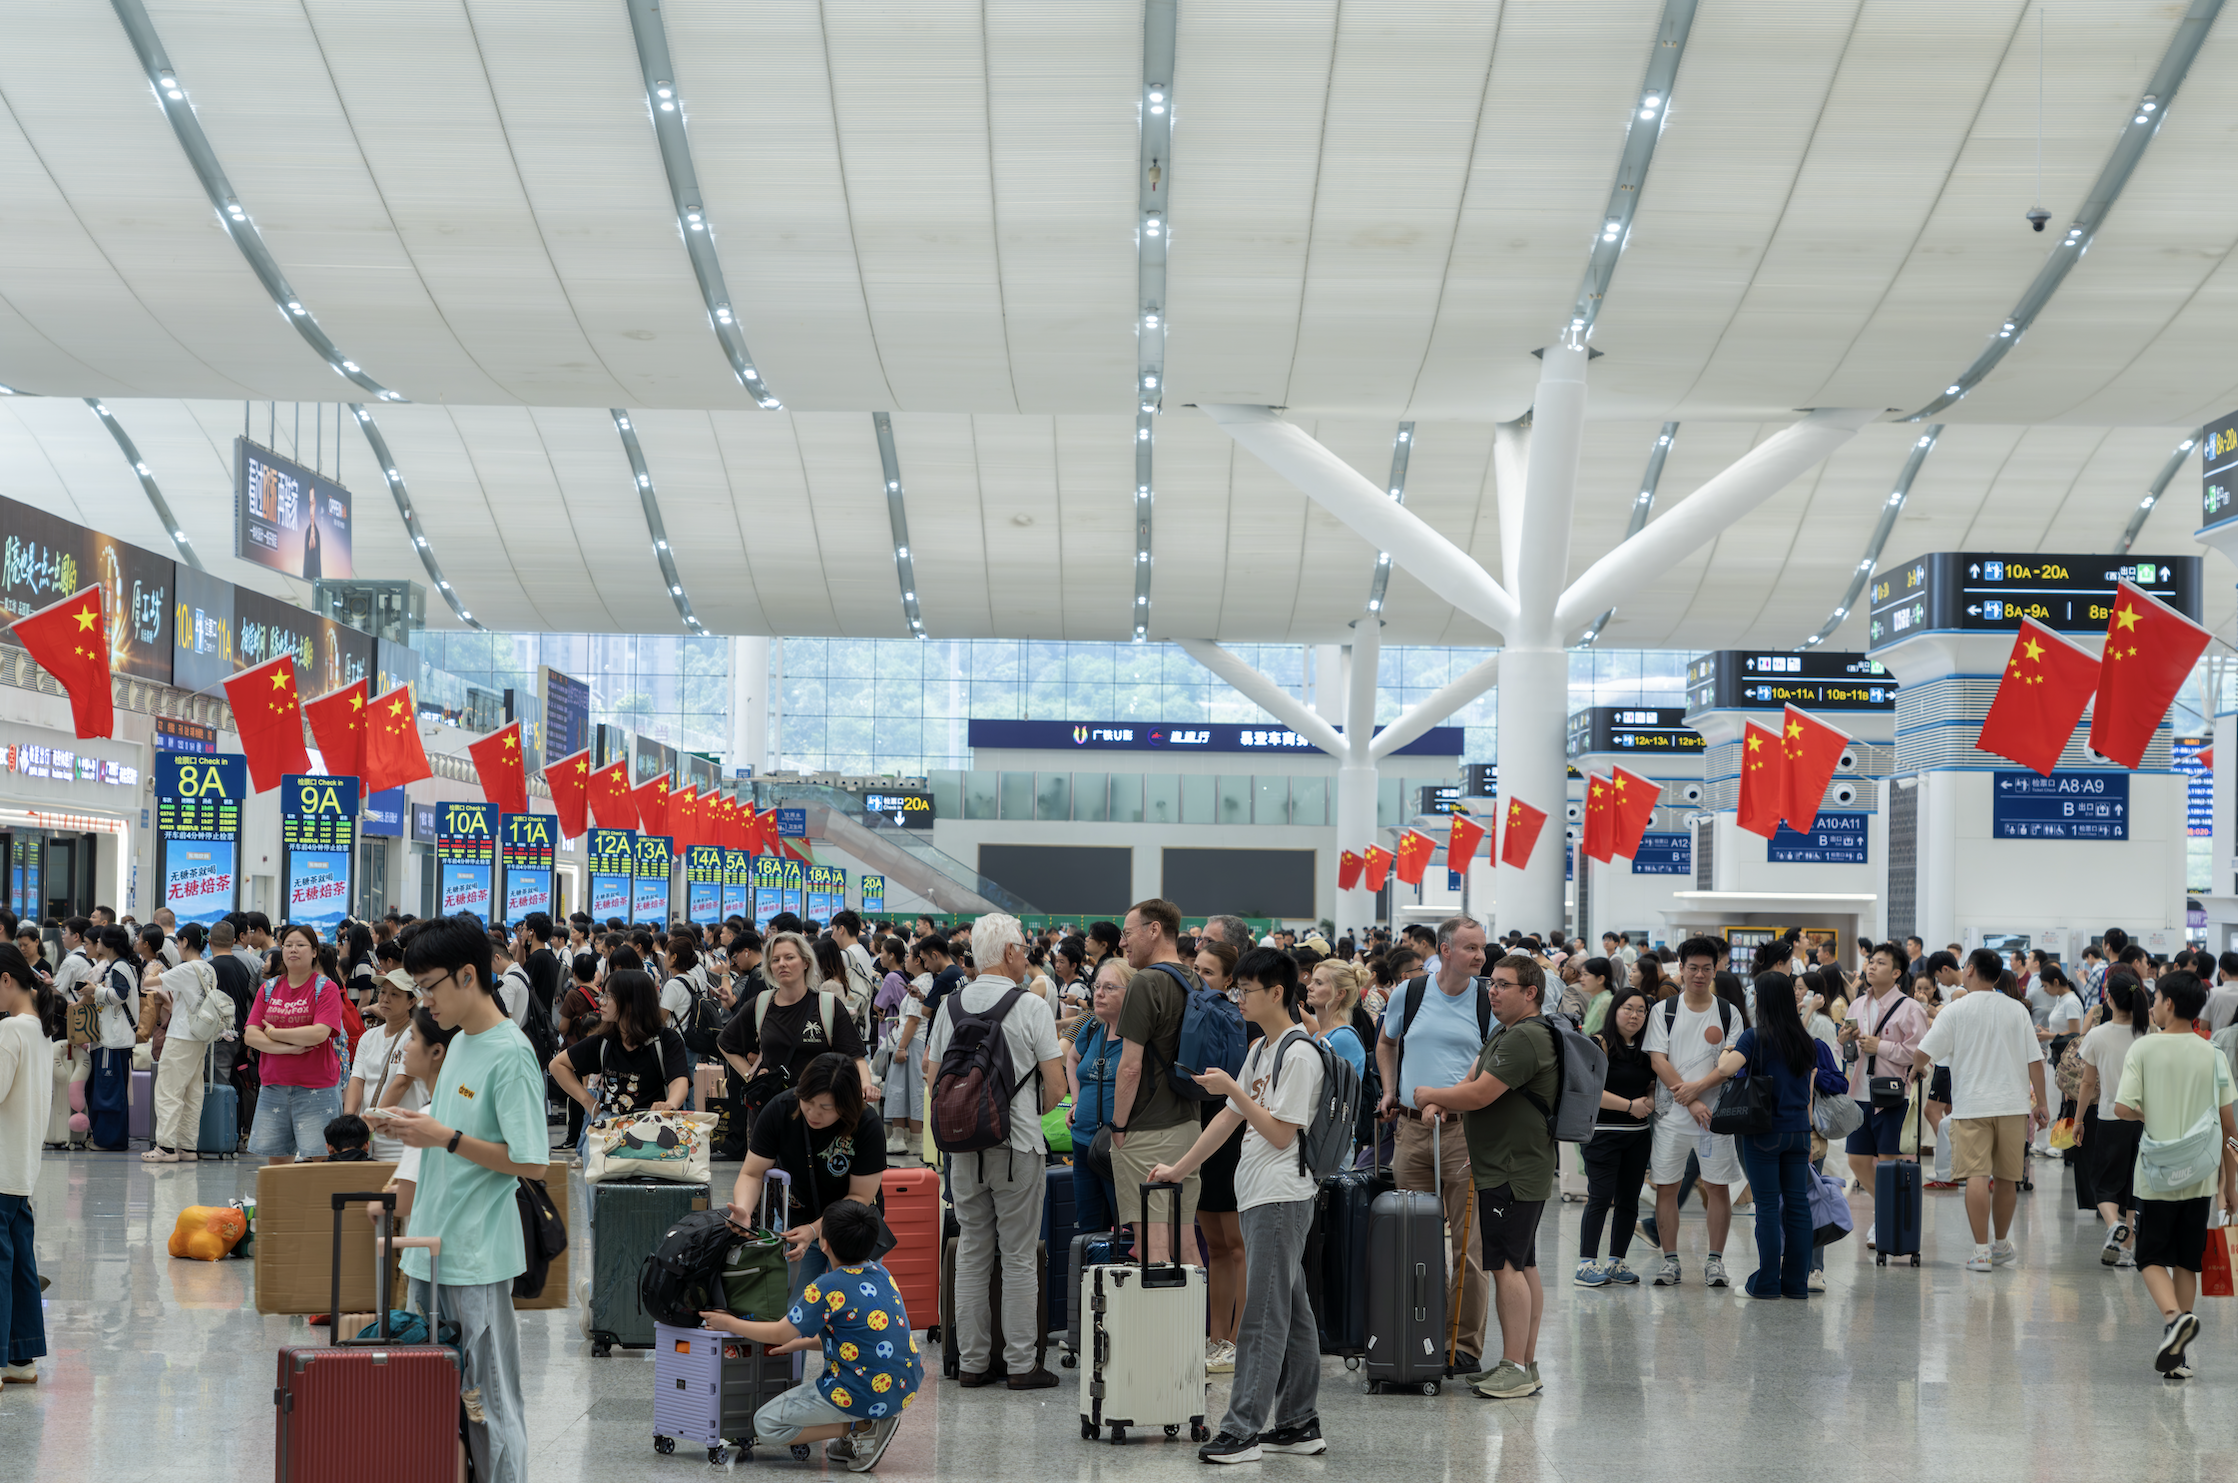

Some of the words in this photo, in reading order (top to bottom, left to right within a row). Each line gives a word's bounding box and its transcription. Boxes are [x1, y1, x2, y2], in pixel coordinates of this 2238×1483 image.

[176, 602, 194, 650] 10A
[217, 617, 232, 662] 11A
[1772, 688, 1815, 700] 10A-11A
[1826, 689, 1869, 701] 10B-11B
[1634, 736, 1669, 746] 12A-13A
[1678, 737, 1707, 746] 12B-13
[198, 757, 220, 765] Check
[178, 765, 226, 797] 8A
[2032, 779, 2056, 787] 检票口
[300, 786, 342, 814] 9A
[903, 796, 930, 811] 20A
[2063, 802, 2075, 816] B
[445, 811, 488, 834] 10A
[509, 822, 549, 843] 11A
[594, 835, 631, 854] 12A
[1819, 835, 1828, 846] B
[635, 841, 668, 859] 13A
[1672, 852, 1680, 861] B
[691, 850, 721, 866] 14A
[726, 855, 747, 870] 5A
[170, 864, 217, 882] 无糖茶就喝
[756, 861, 783, 875] 16A
[784, 863, 801, 876] 7A
[808, 869, 831, 881] 18A
[167, 874, 231, 900] 无糖焙茶
[293, 872, 334, 888] 无糖茶就喝
[863, 879, 883, 888] 20A
[291, 881, 346, 904] 无糖焙茶
[444, 889, 488, 908] 无糖焙茶
[508, 892, 548, 909] 无糖焙茶
[593, 896, 628, 911] 无糖焙茶
[634, 898, 666, 912] 无糖焙茶
[270, 998, 283, 1006] THE
[266, 1005, 291, 1015] ROWN
[291, 1006, 310, 1014] FOX
[458, 1083, 475, 1099] drew
[2171, 1166, 2192, 1180] NIKE
